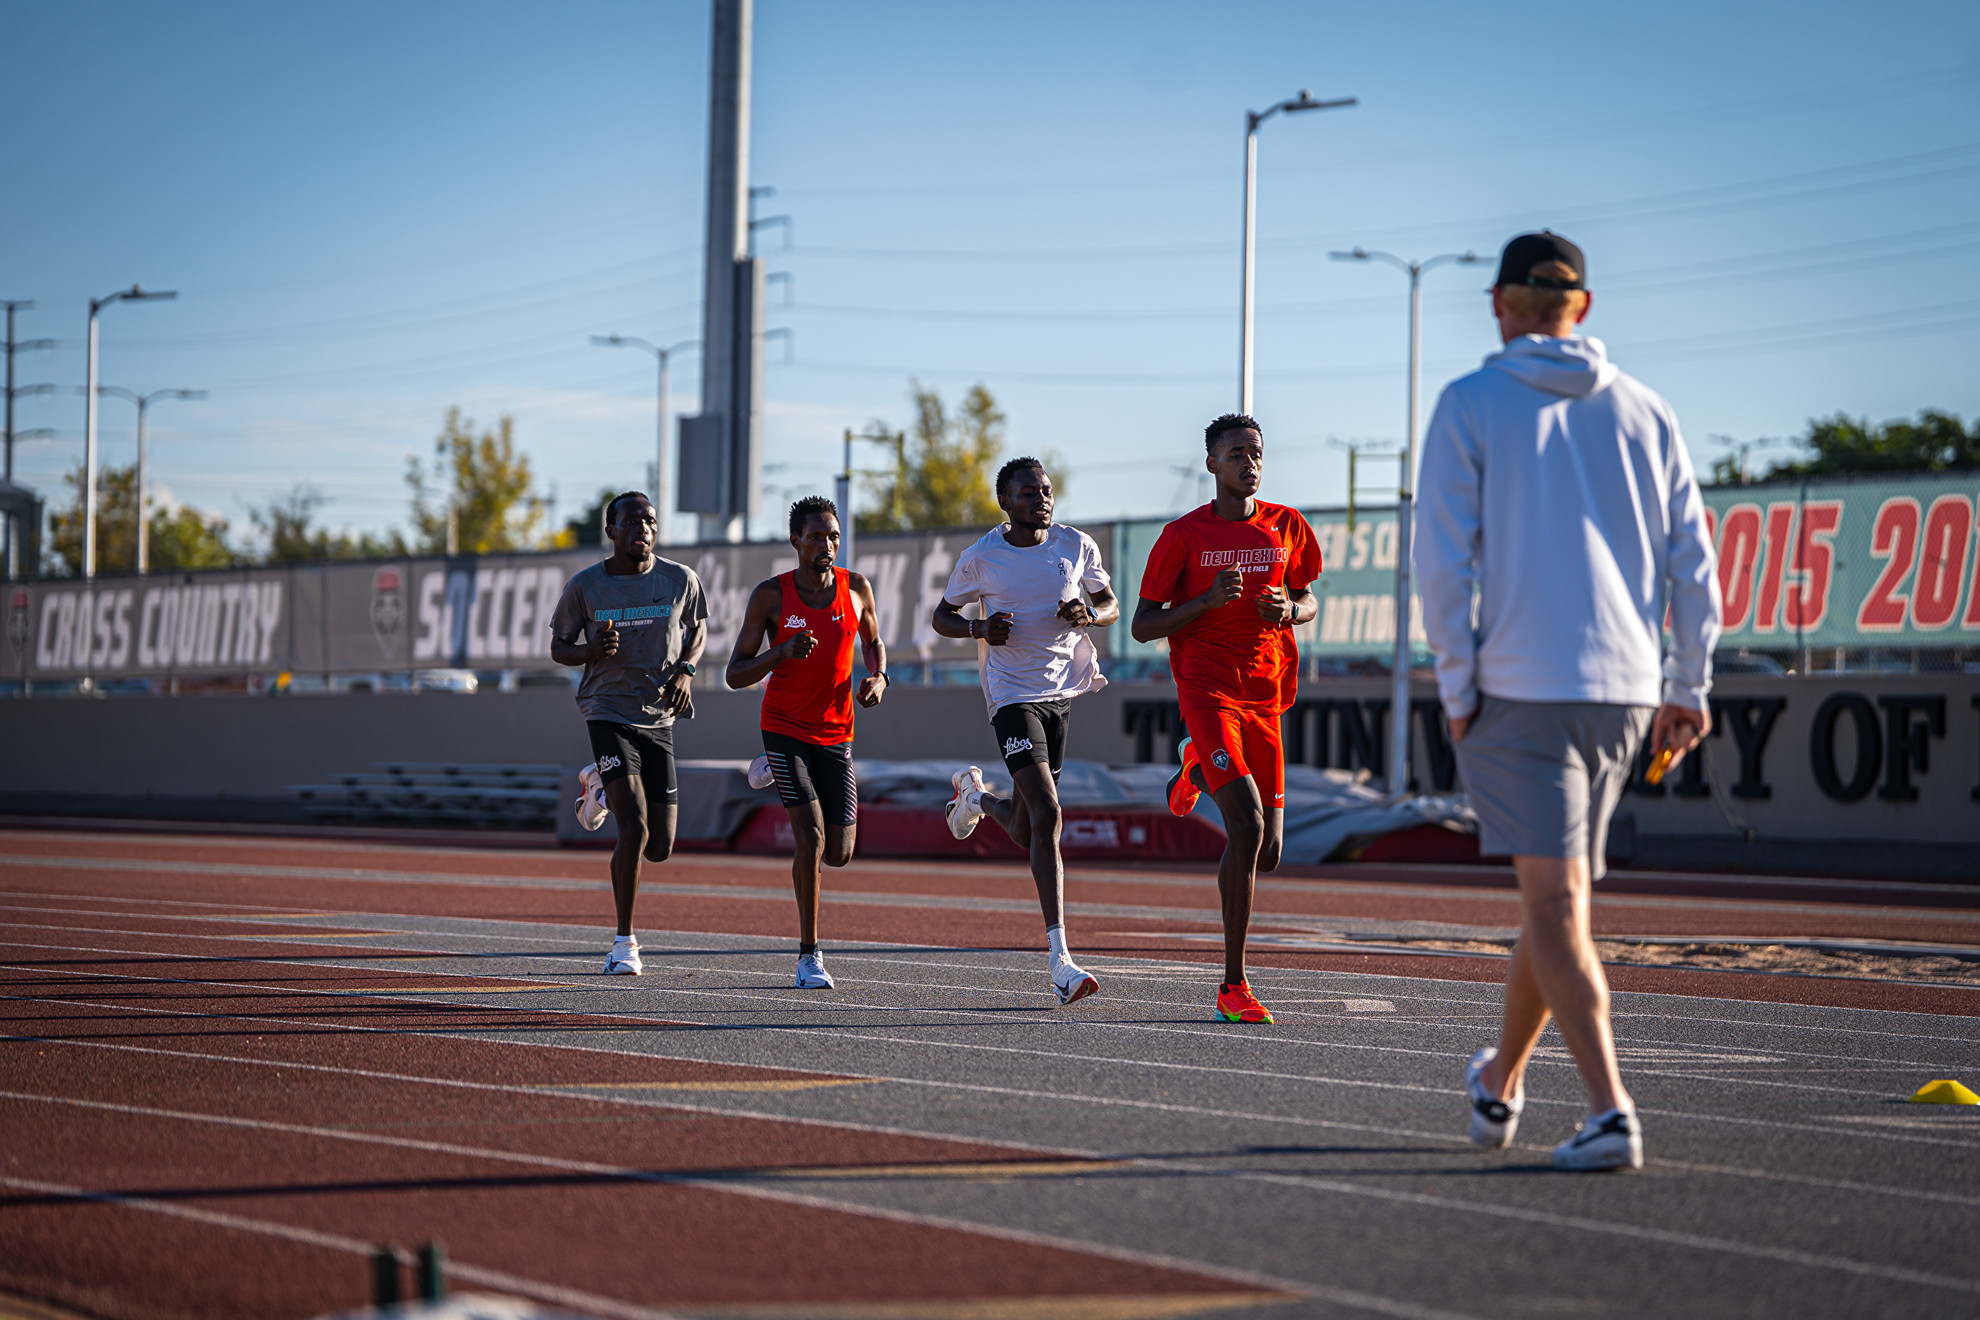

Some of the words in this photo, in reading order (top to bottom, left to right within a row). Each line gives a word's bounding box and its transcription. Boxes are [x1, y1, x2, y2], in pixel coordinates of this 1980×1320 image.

[1238, 547, 1288, 564] MEXICO
[1252, 565, 1269, 573] FIELD
[1664, 502, 1844, 634] 015
[413, 566, 564, 661] SOCCER
[623, 604, 672, 619] MEXICO
[783, 614, 807, 629] Lobos
[36, 590, 135, 670] CROSS
[138, 580, 282, 668] COUNTRY
[615, 620, 630, 628] CROSS
[1003, 736, 1033, 759] Lobos
[1809, 691, 1947, 806] OF
[598, 755, 621, 775] Lobos
